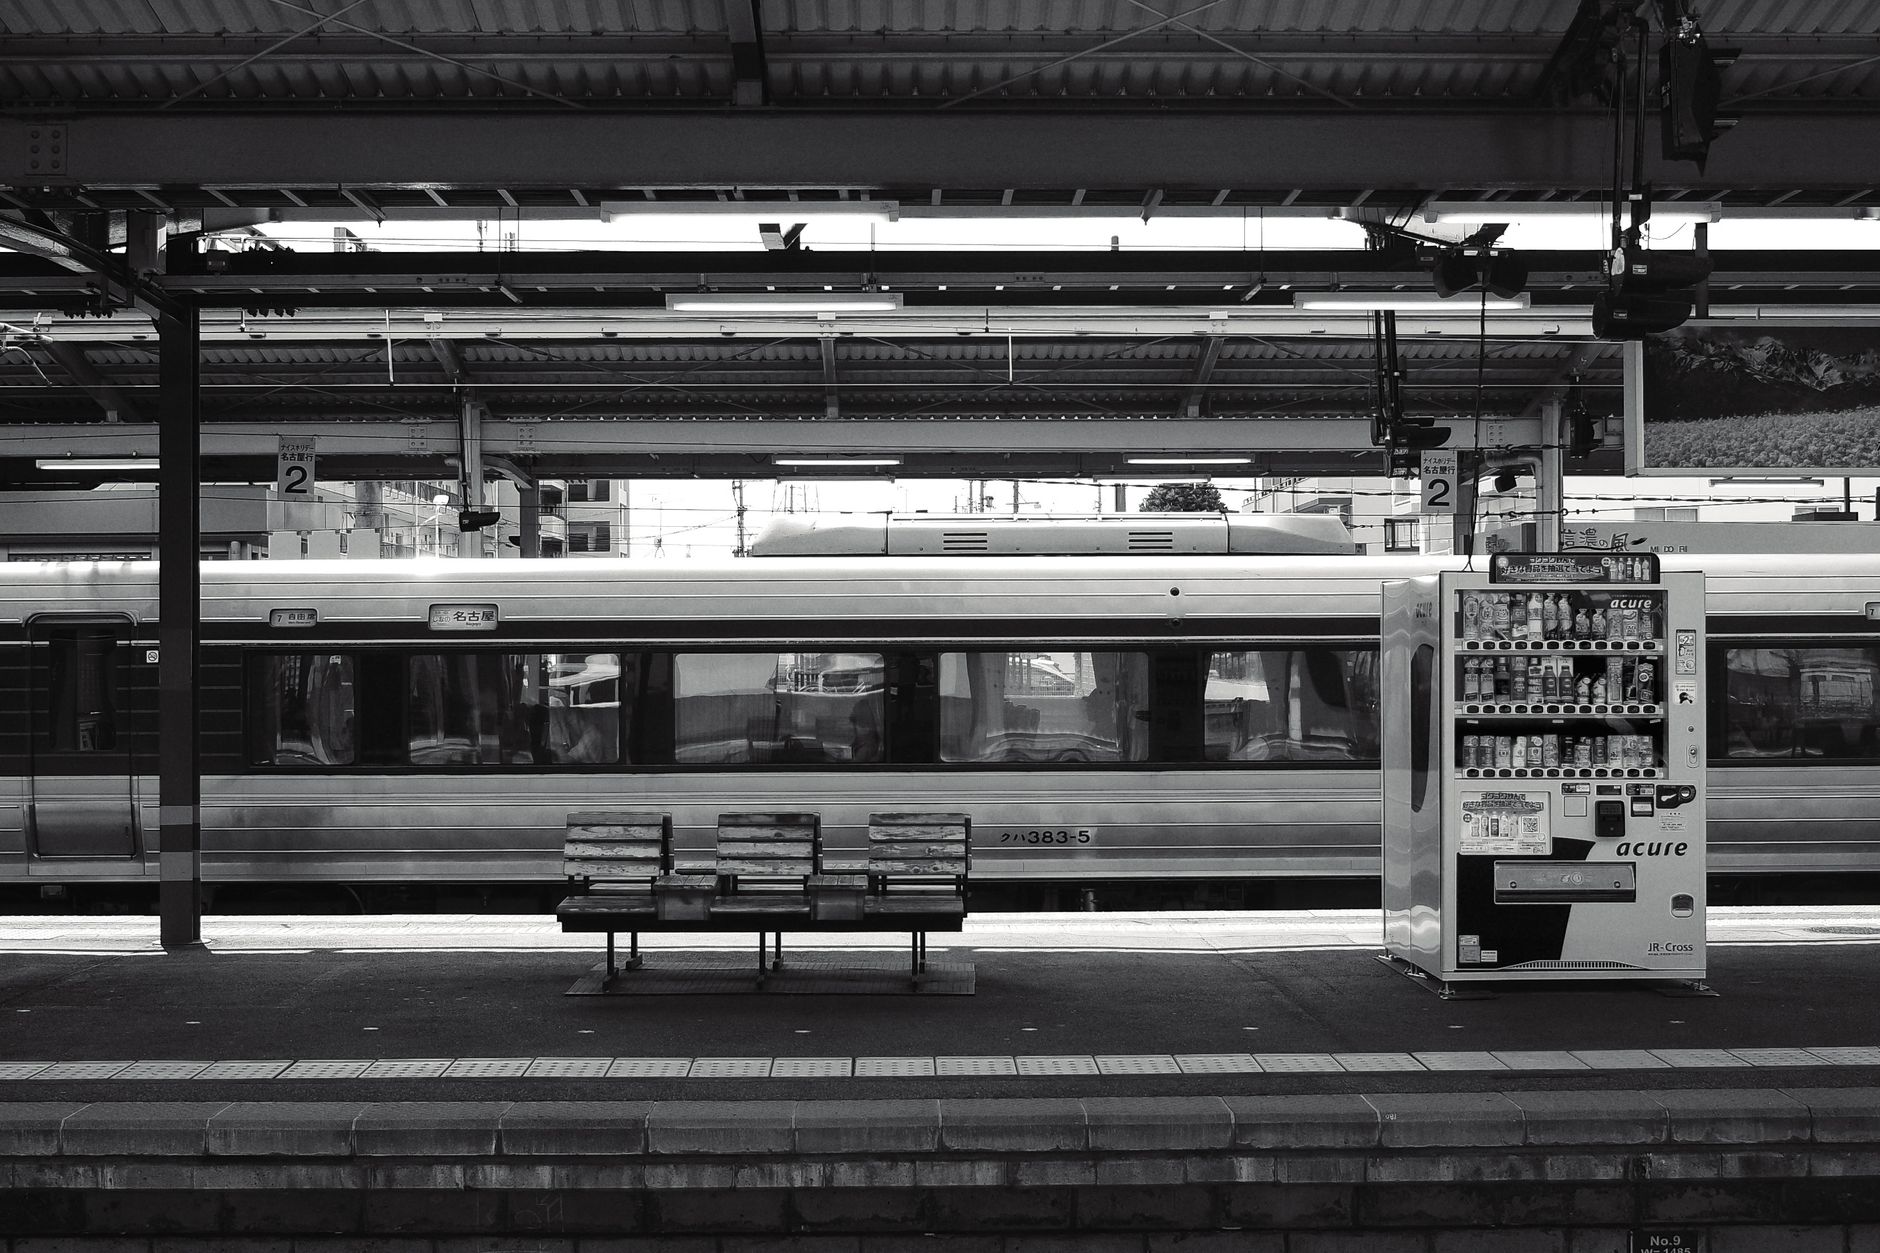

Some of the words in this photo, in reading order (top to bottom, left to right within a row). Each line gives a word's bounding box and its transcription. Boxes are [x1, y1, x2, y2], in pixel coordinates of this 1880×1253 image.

[281, 452, 314, 461] 名古屋行
[1423, 466, 1455, 474] 名古屋行
[285, 465, 308, 493] 2
[1427, 478, 1450, 506] 2
[1610, 599, 1652, 609] acure
[276, 614, 283, 623] 7
[288, 613, 316, 621] 自由席
[453, 610, 496, 622] 名古屋
[1000, 830, 1091, 844] クハ383-5
[1616, 841, 1689, 857] acure
[1647, 942, 1694, 952] JR-Cross
[1650, 1235, 1681, 1246] No.9
